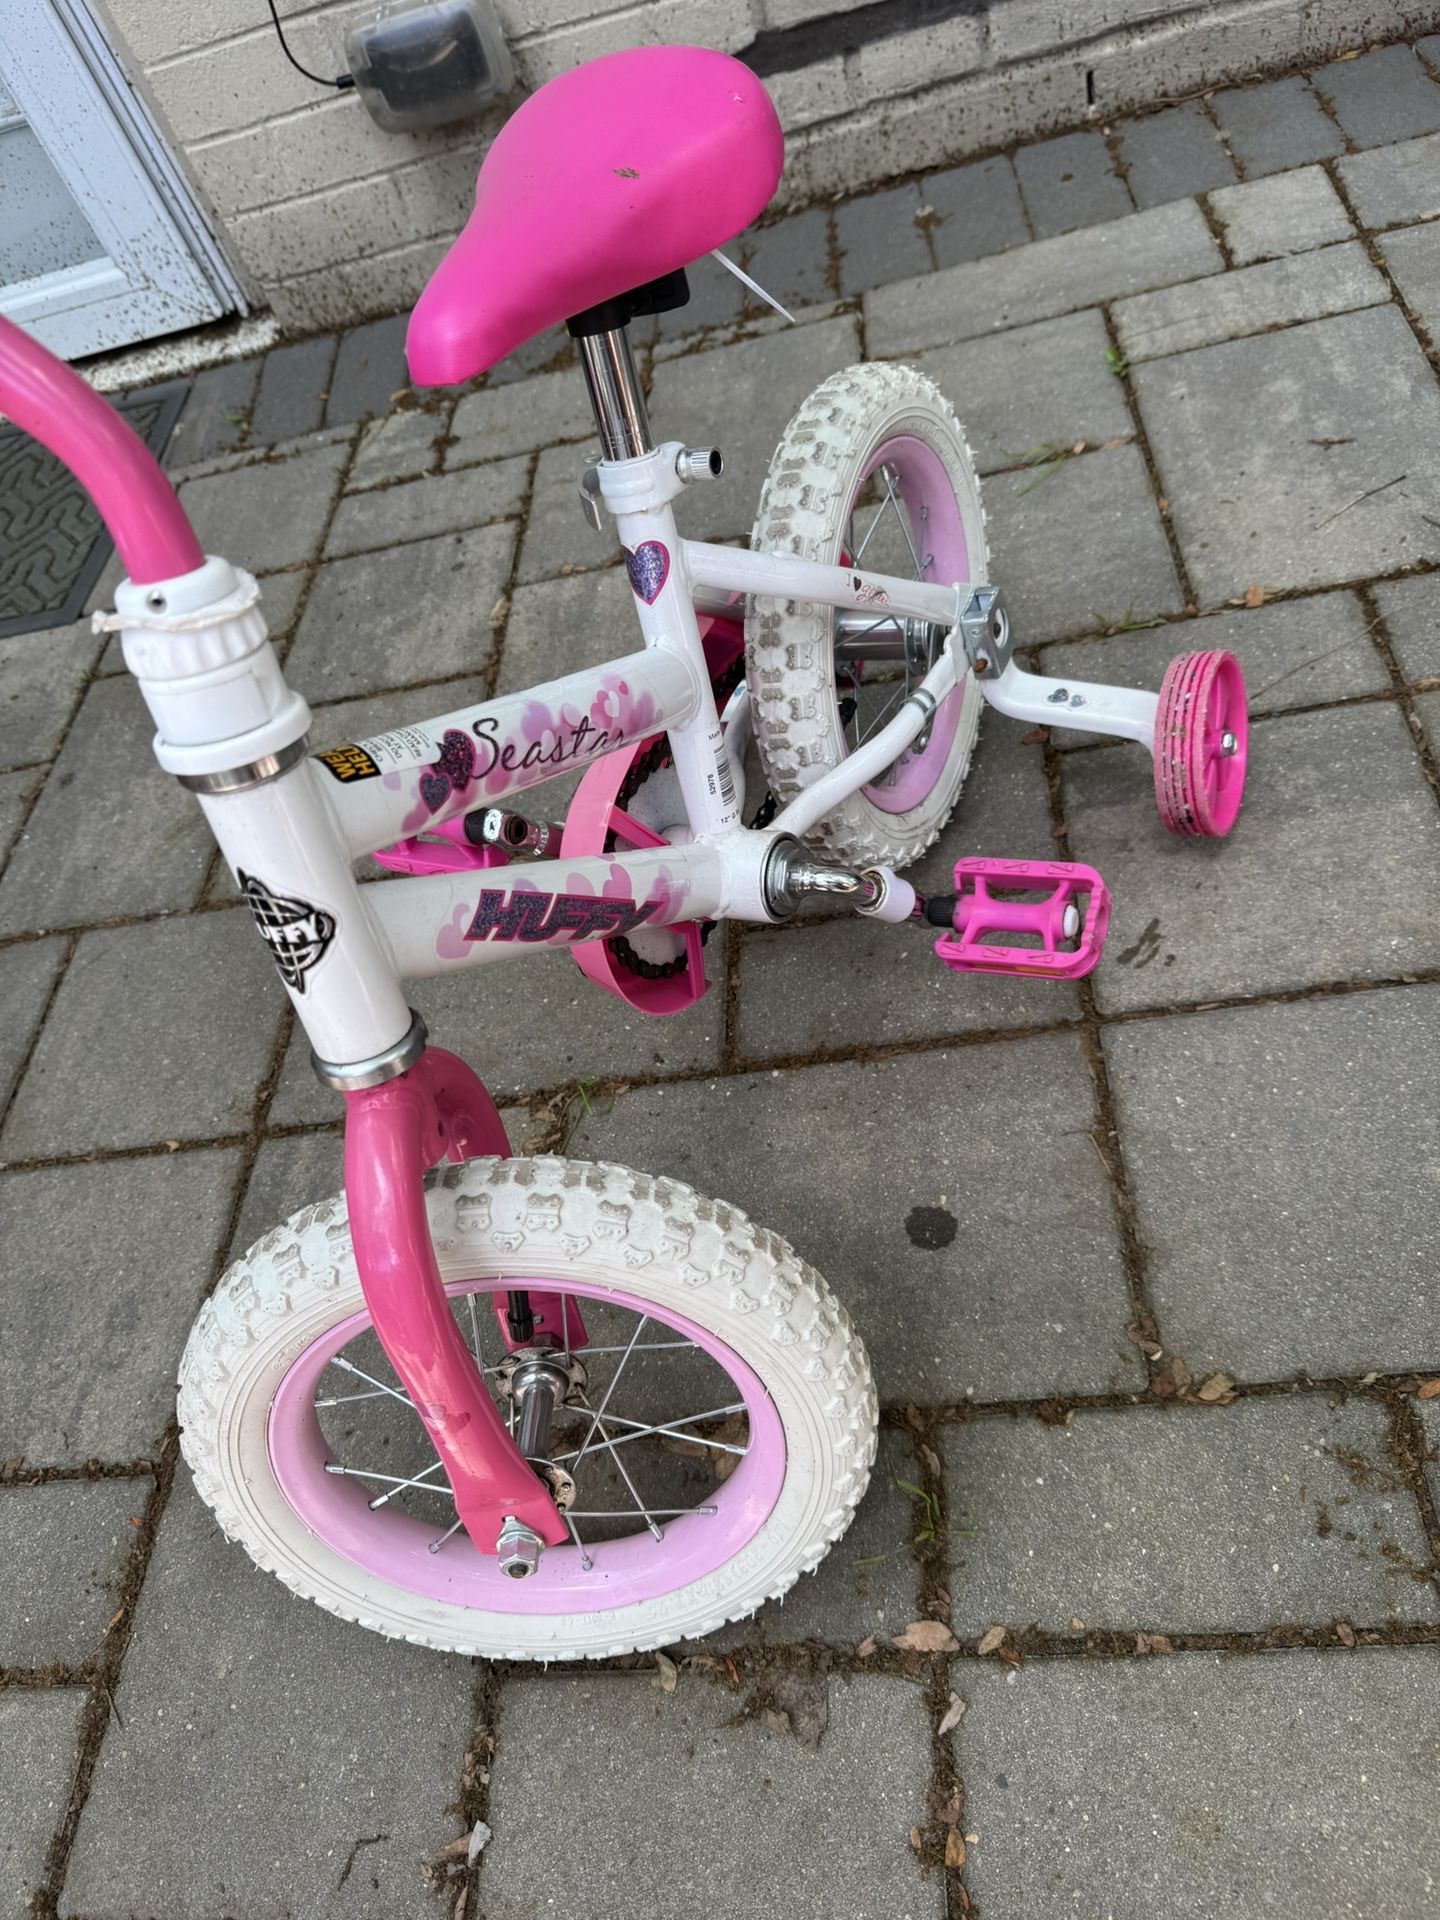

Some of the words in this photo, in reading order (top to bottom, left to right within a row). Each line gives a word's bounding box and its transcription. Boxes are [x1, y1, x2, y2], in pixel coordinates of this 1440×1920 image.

[335, 745, 376, 775] HEL
[470, 715, 625, 779] Seastar
[463, 888, 665, 942] HUFFY
